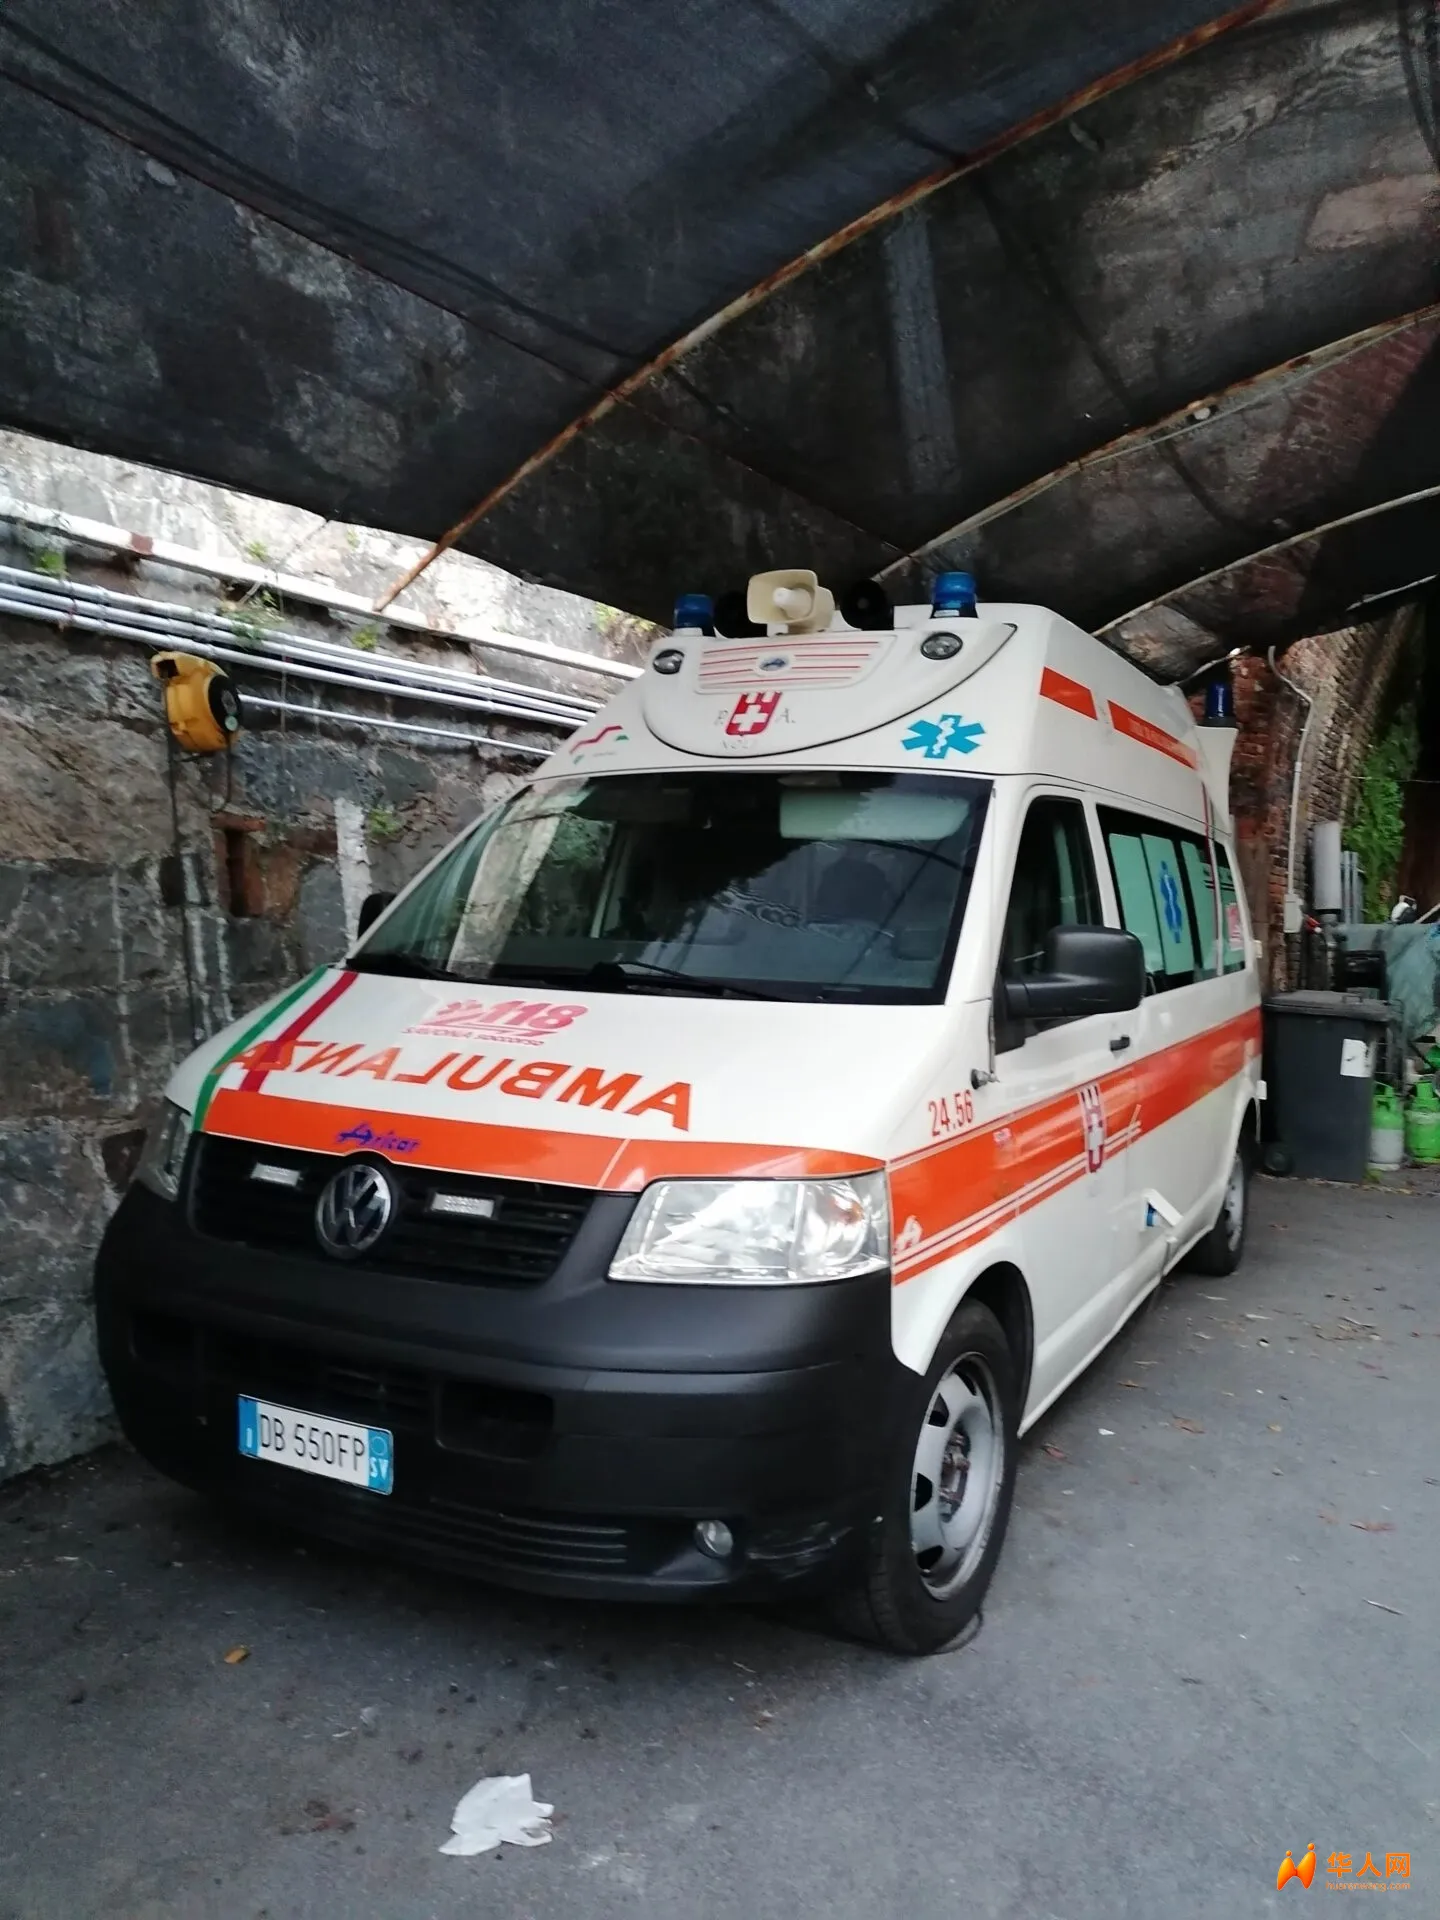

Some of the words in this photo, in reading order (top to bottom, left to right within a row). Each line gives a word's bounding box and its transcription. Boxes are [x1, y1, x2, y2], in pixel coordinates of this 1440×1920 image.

[479, 1000, 588, 1029] 118
[928, 1089, 973, 1137] 24.56
[259, 1414, 286, 1451] DB
[293, 1423, 366, 1471] 550FP
[369, 1456, 389, 1480] SV
